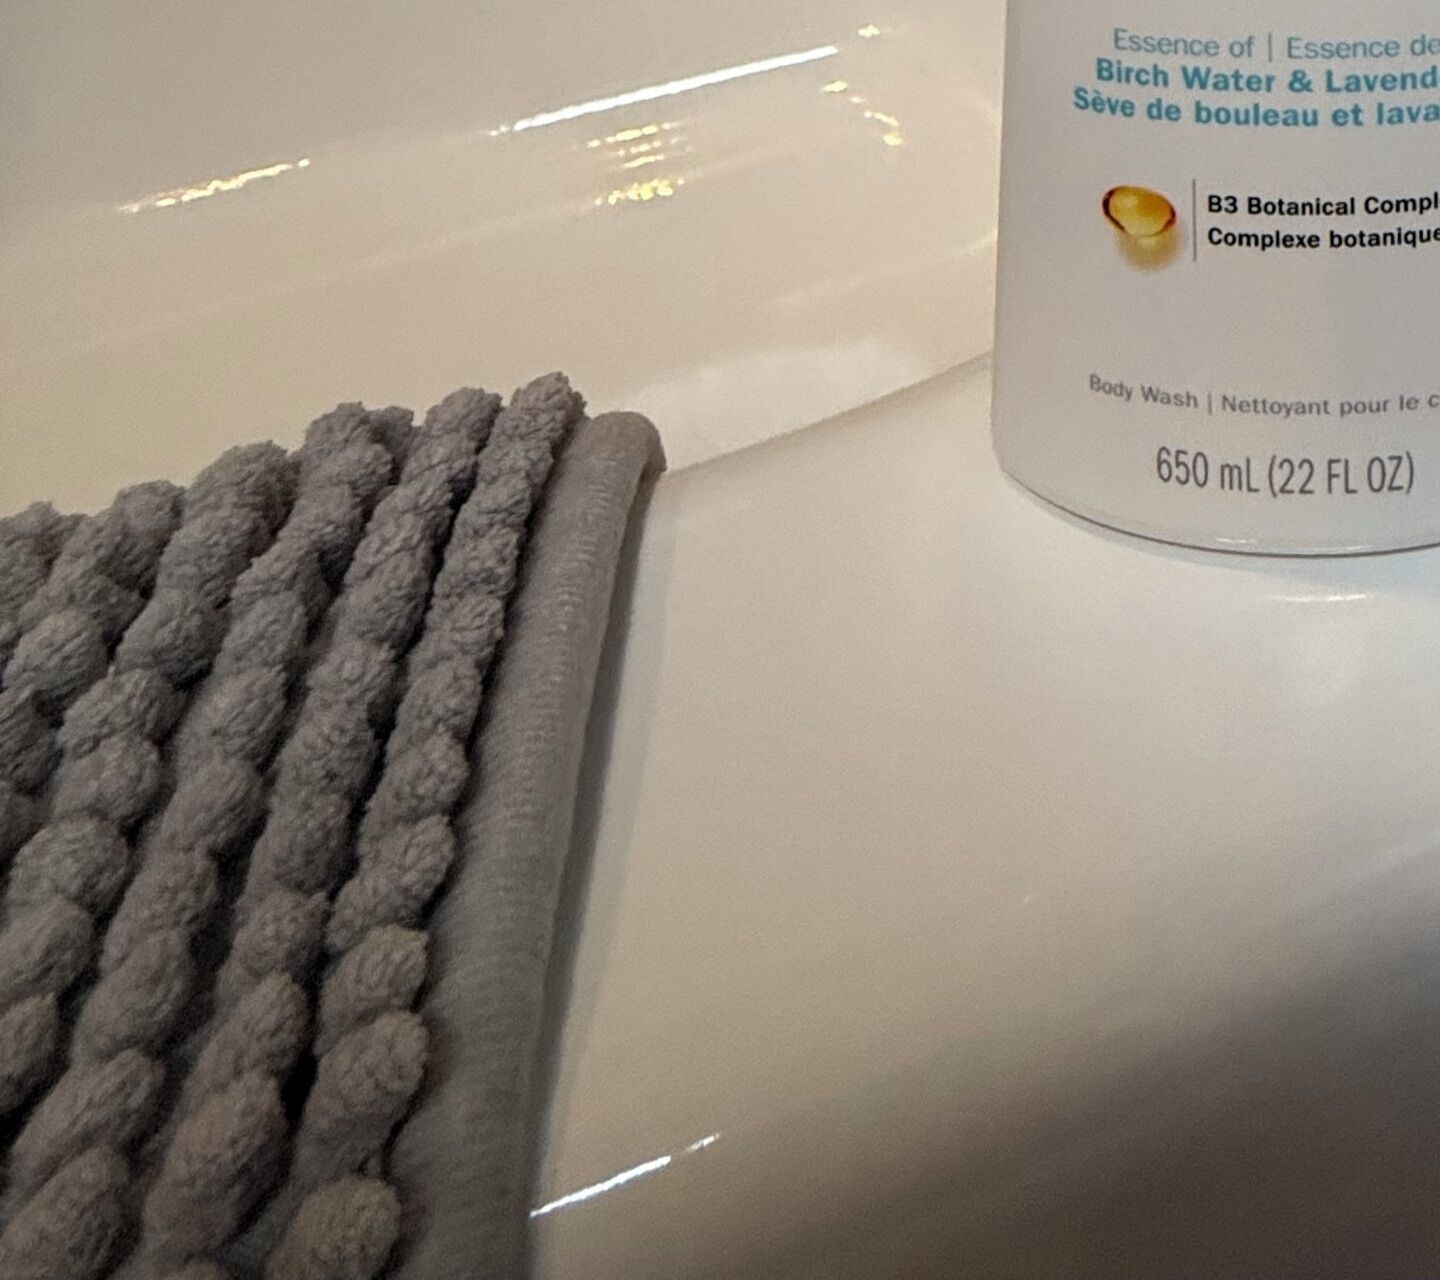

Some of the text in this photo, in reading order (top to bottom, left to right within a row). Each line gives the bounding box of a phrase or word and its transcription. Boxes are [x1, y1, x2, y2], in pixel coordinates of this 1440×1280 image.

[1114, 28, 1220, 58] Essence
[1230, 36, 1255, 57] of
[1287, 37, 1400, 60] Essence
[1096, 58, 1169, 87] Birch
[1181, 66, 1275, 93] Water
[1289, 70, 1313, 93] &
[1073, 87, 1135, 118] Sève
[1147, 98, 1181, 121] de
[1194, 101, 1318, 127] bouleau
[1332, 104, 1363, 126] et
[1208, 194, 1238, 214] B3
[1247, 196, 1355, 216] Botanical
[1208, 228, 1320, 251] Complexe
[1089, 373, 1133, 403] Body
[1141, 385, 1198, 409] Wash
[1222, 395, 1330, 418] Nettoyant
[1340, 398, 1388, 418] pour
[1400, 394, 1418, 411] le
[1157, 446, 1414, 498] 650 mL (22 FL OZ)
